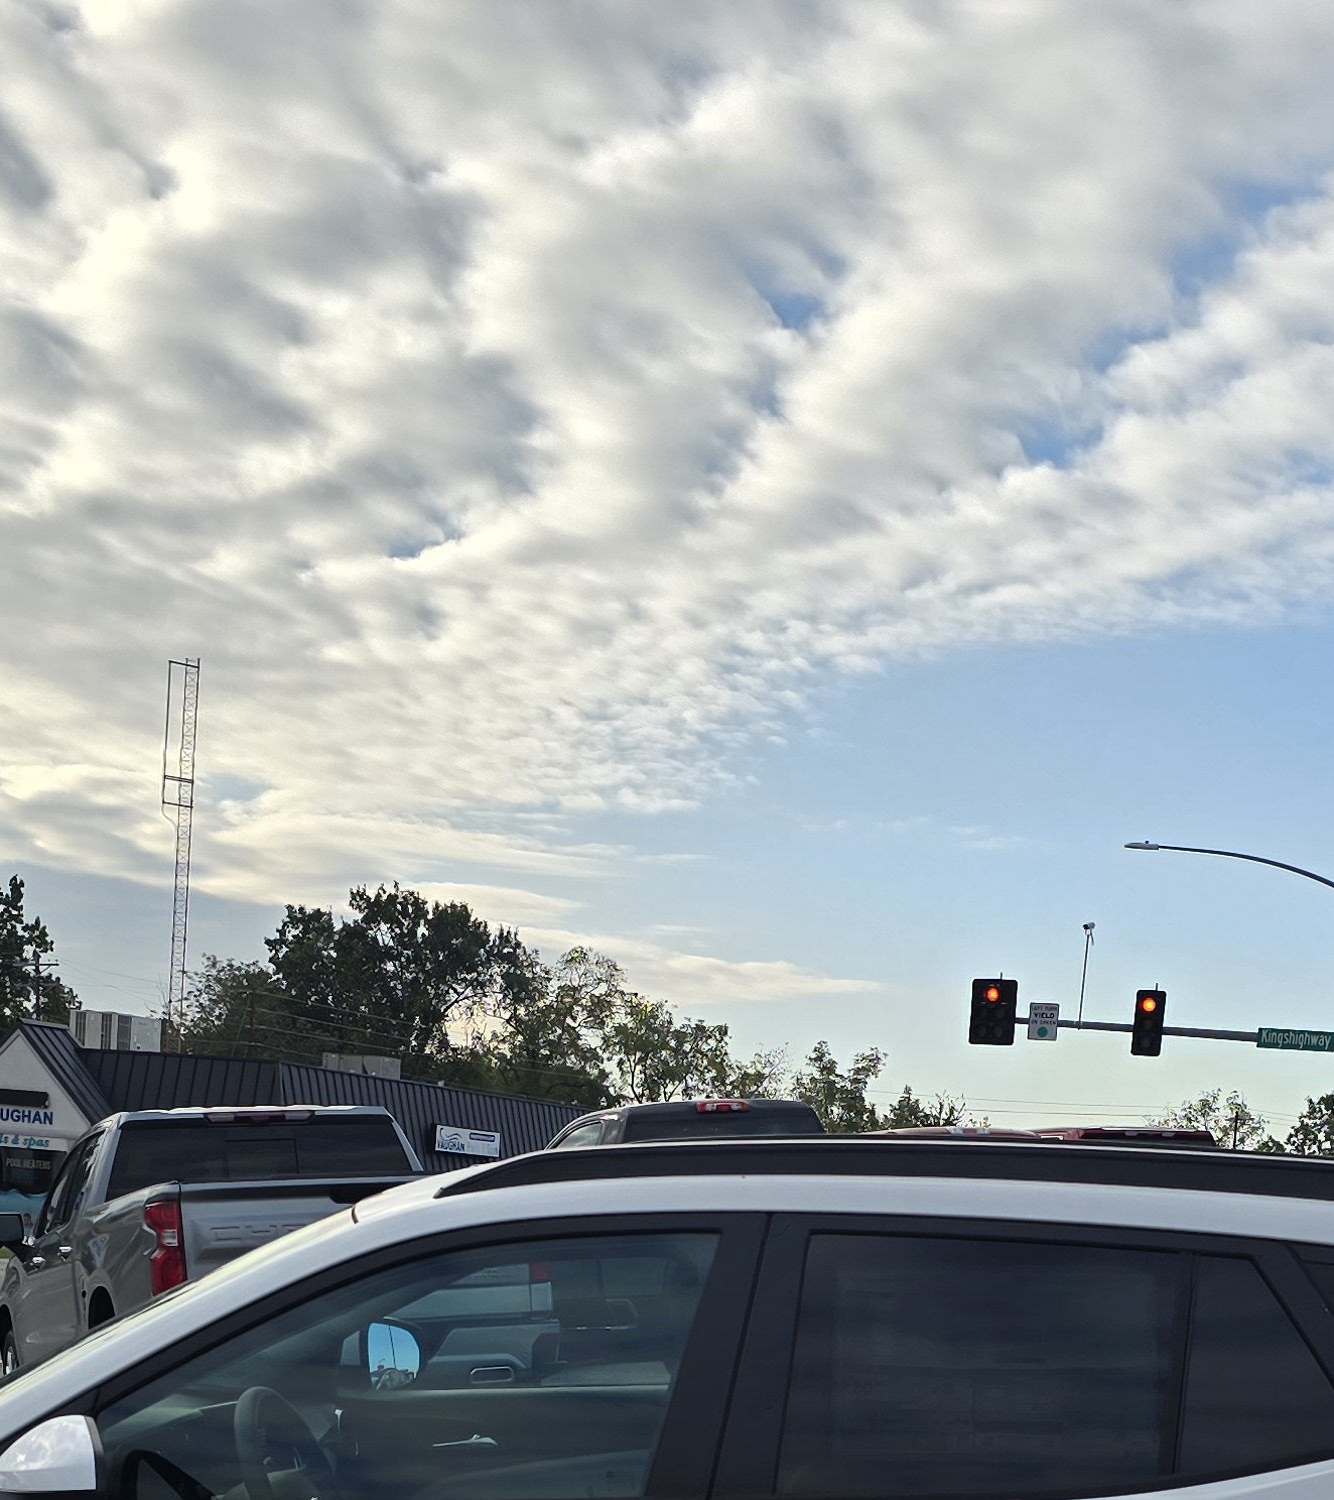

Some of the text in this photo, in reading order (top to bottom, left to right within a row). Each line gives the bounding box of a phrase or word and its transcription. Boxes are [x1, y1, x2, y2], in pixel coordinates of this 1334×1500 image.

[1261, 1029, 1331, 1050] Kingshighway
[22, 1137, 50, 1149] spas
[5, 1157, 51, 1170] POOL HEATERS
